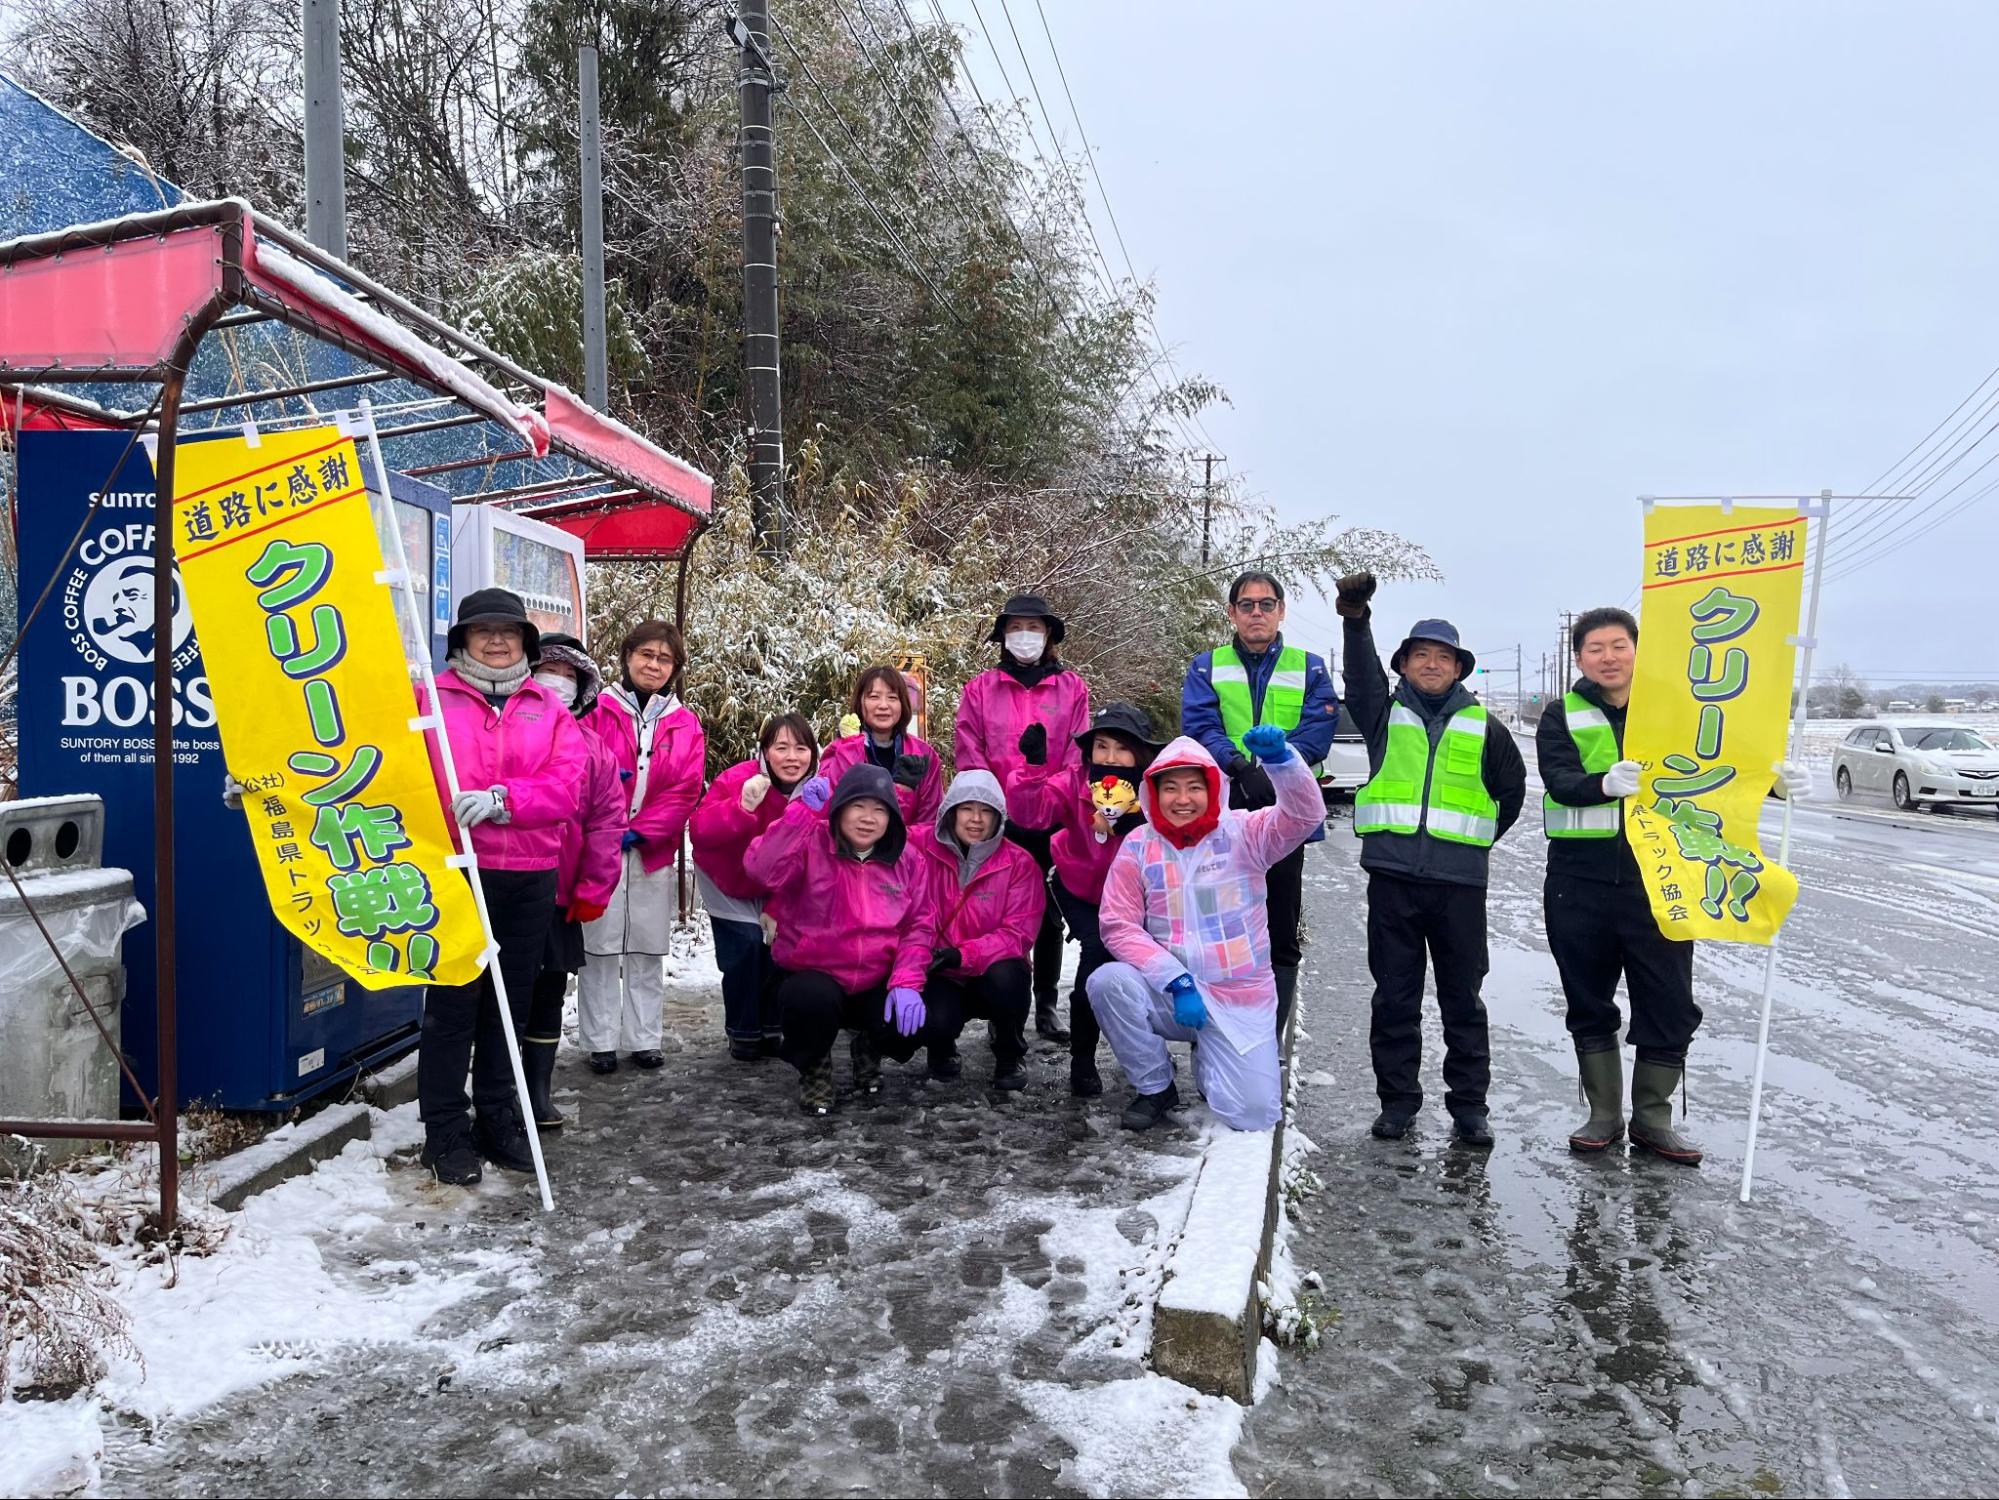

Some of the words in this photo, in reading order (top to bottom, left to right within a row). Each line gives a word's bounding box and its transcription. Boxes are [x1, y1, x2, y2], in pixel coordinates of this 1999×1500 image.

[183, 451, 349, 544] 道路に感謝
[79, 524, 156, 566] COFF
[1654, 529, 1796, 578] 道路に感謝
[63, 567, 88, 630] COFFEE
[71, 633, 108, 671] BOSS
[60, 737, 119, 749] SUNTORY
[123, 738, 155, 749] BOSS
[172, 739, 190, 750] the
[192, 738, 220, 750] boss
[80, 752, 91, 763] of
[94, 752, 121, 763] them
[124, 752, 137, 763] all
[139, 752, 156, 763] sin
[172, 753, 199, 764] 1992
